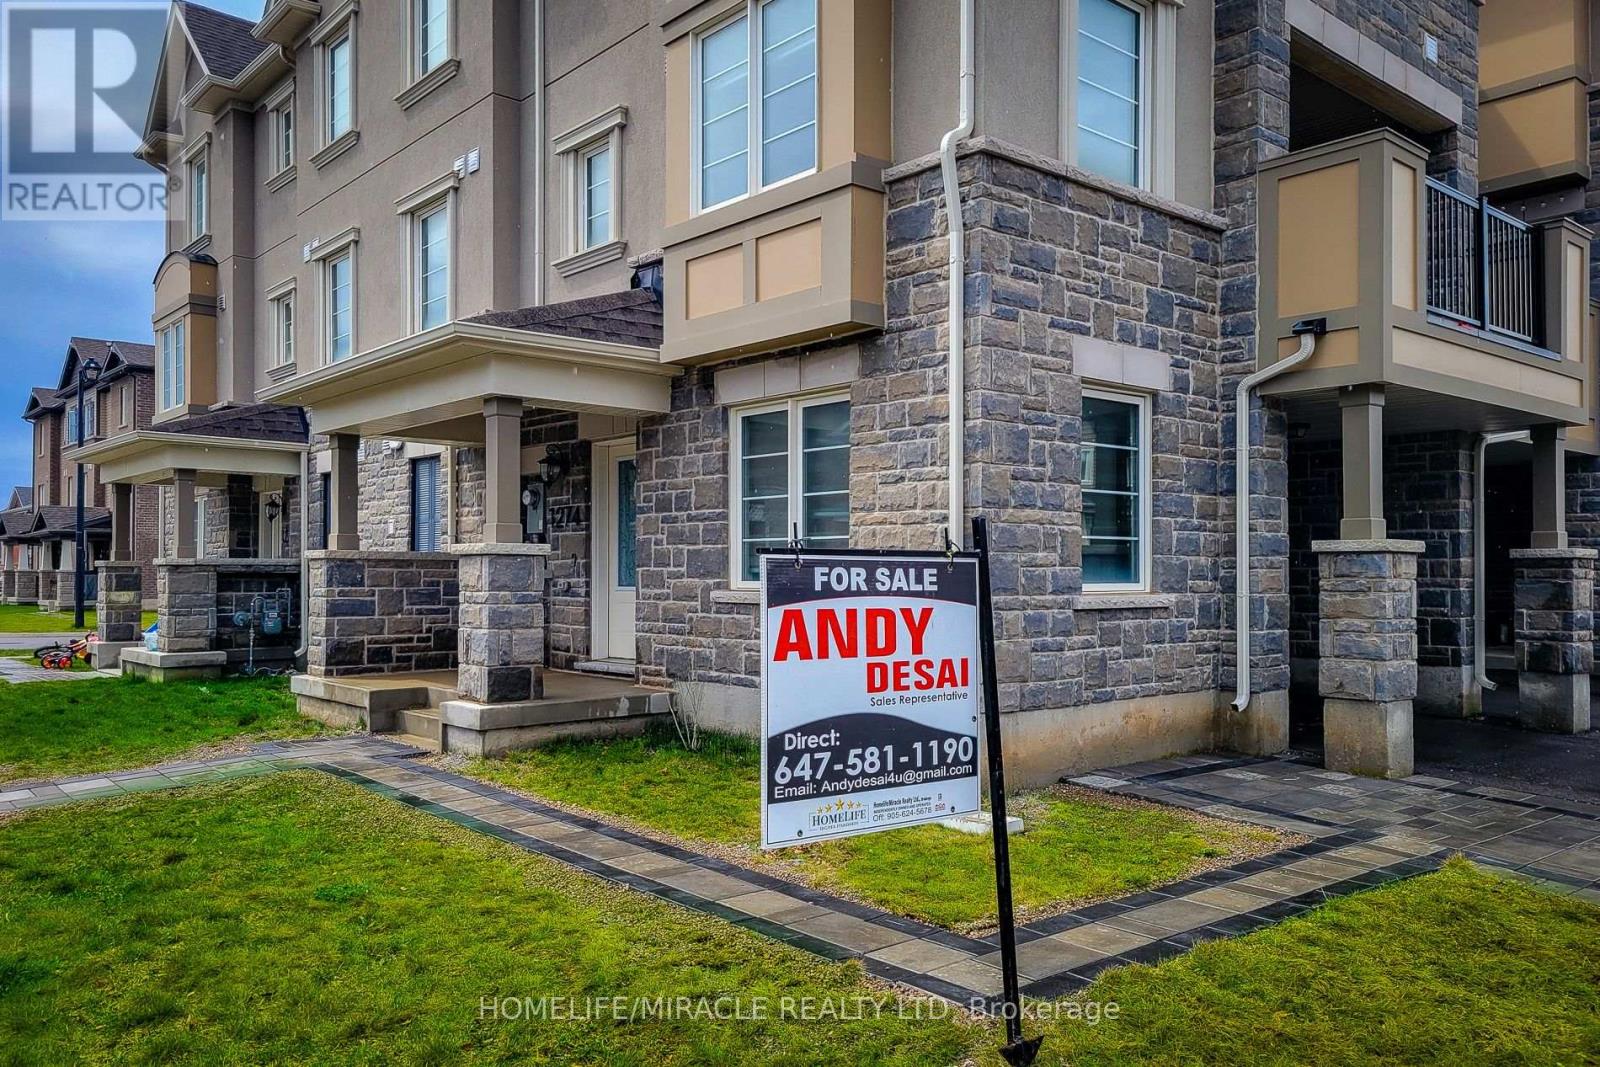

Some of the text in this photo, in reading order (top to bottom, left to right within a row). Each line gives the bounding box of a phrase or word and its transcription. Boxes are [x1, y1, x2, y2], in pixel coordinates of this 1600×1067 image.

[814, 566, 938, 592] FOR SALE
[773, 607, 934, 662] ANDY
[866, 657, 969, 694] DESAI
[870, 690, 969, 707] Sales Representative
[784, 729, 840, 751] Direct:
[774, 736, 974, 785] 647-581-1190
[774, 764, 973, 799] Email: Andydesai4u@gmail.com
[812, 808, 867, 827] HOMELIFE
